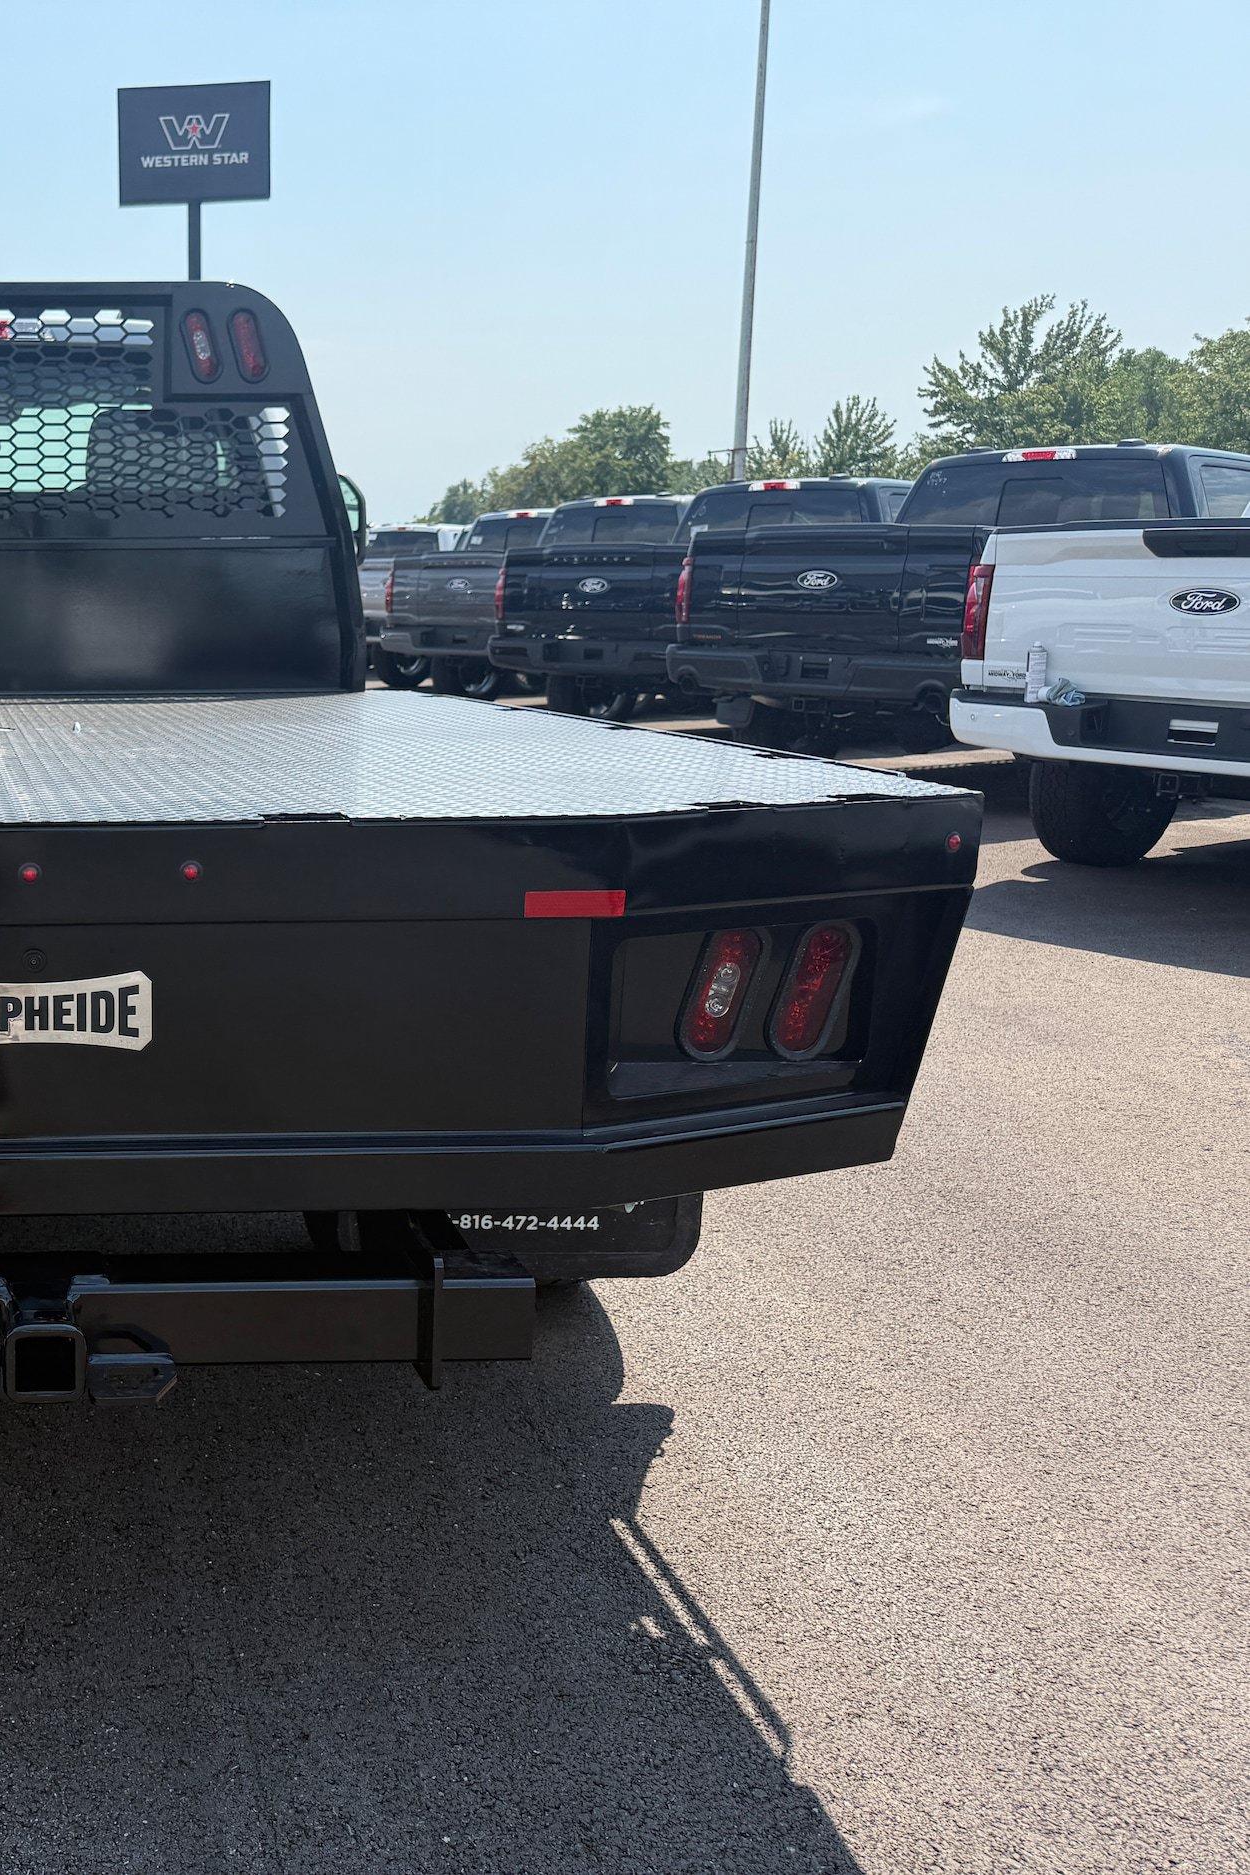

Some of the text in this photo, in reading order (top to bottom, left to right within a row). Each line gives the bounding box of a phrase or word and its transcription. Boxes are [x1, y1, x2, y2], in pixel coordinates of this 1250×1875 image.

[140, 152, 249, 169] WESTERN STAR
[1181, 592, 1228, 610] Ford
[447, 1213, 600, 1231] -816-472-4444
